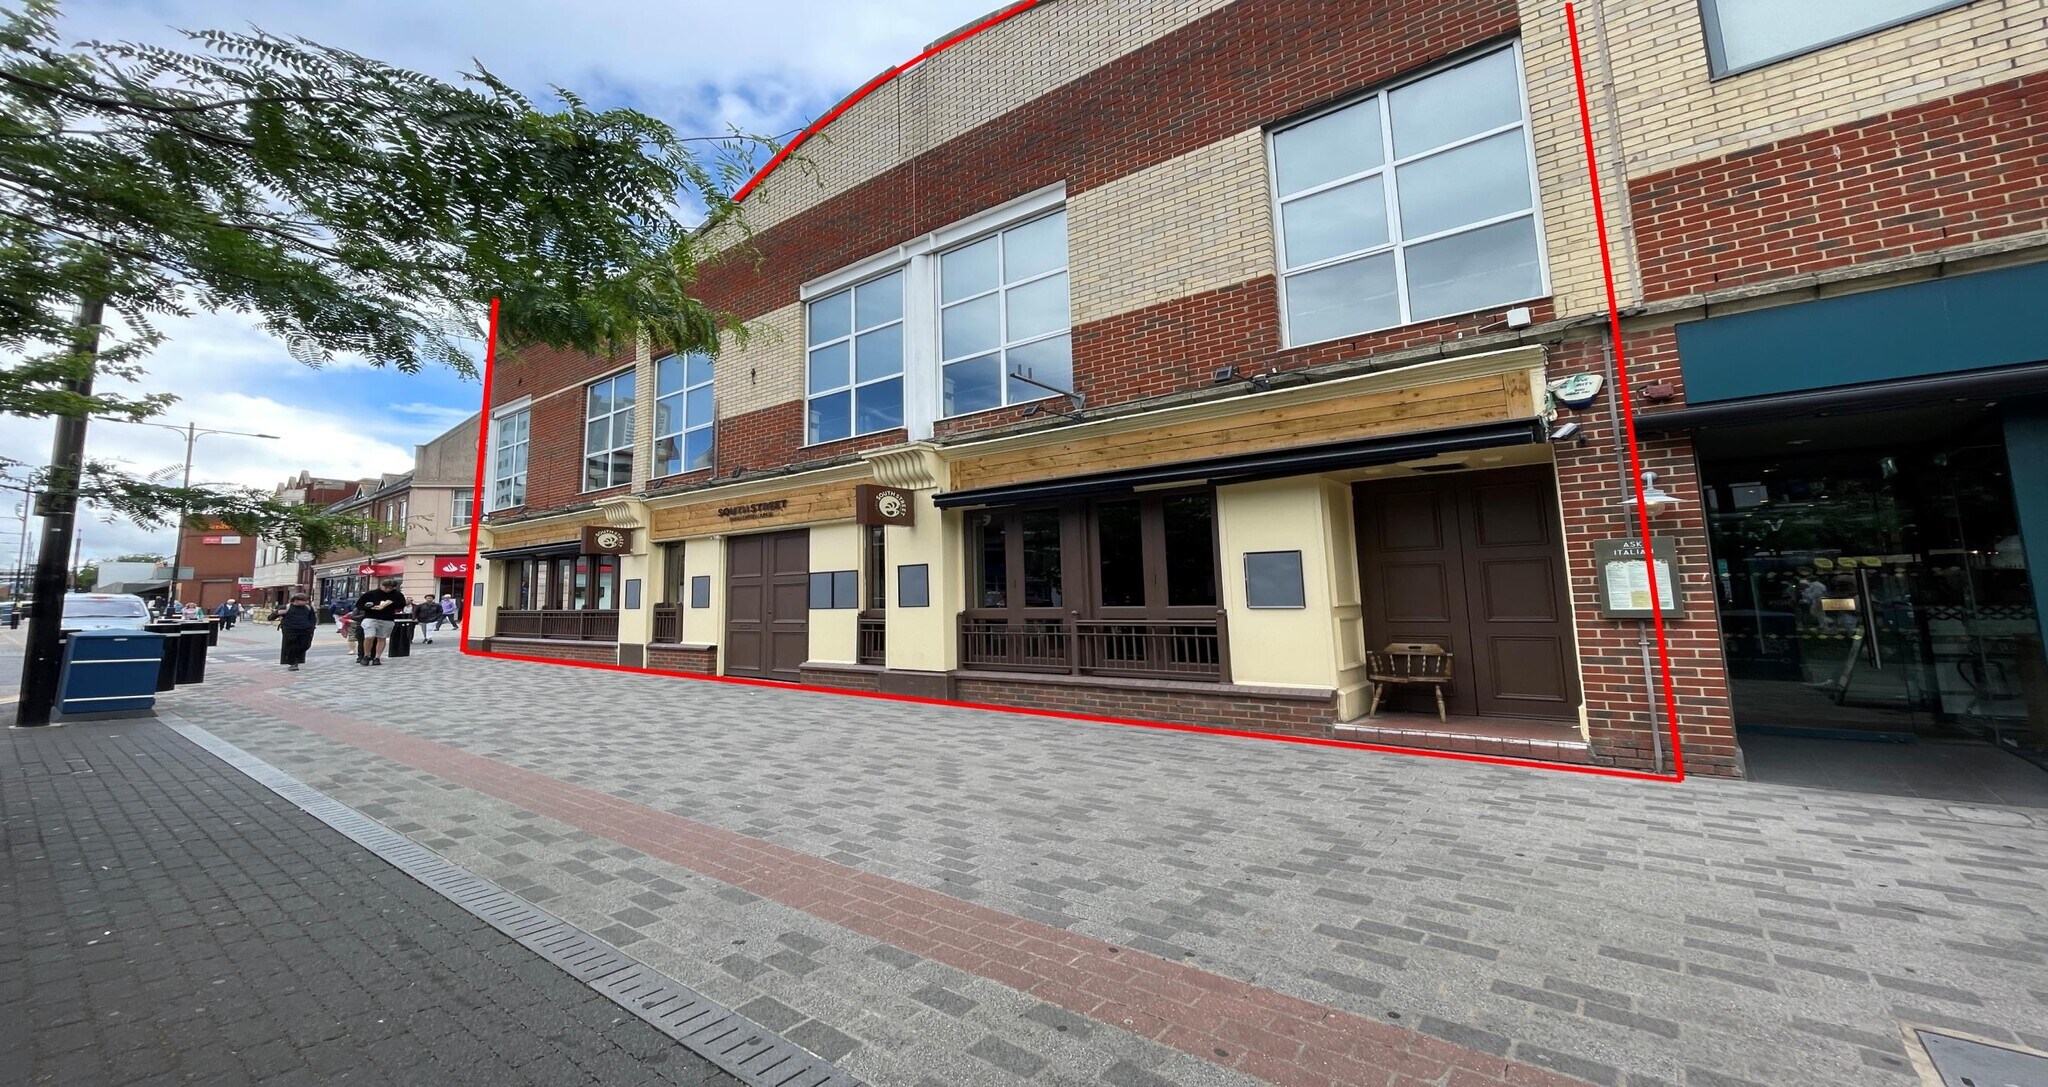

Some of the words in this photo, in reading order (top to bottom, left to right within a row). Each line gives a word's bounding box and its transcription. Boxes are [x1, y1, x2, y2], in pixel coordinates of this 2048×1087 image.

[717, 504, 750, 516] SOUTH
[751, 499, 787, 512] STREET
[876, 491, 895, 500] SOUTH
[896, 494, 907, 516] STREET
[1613, 548, 1654, 556] ITALIA
